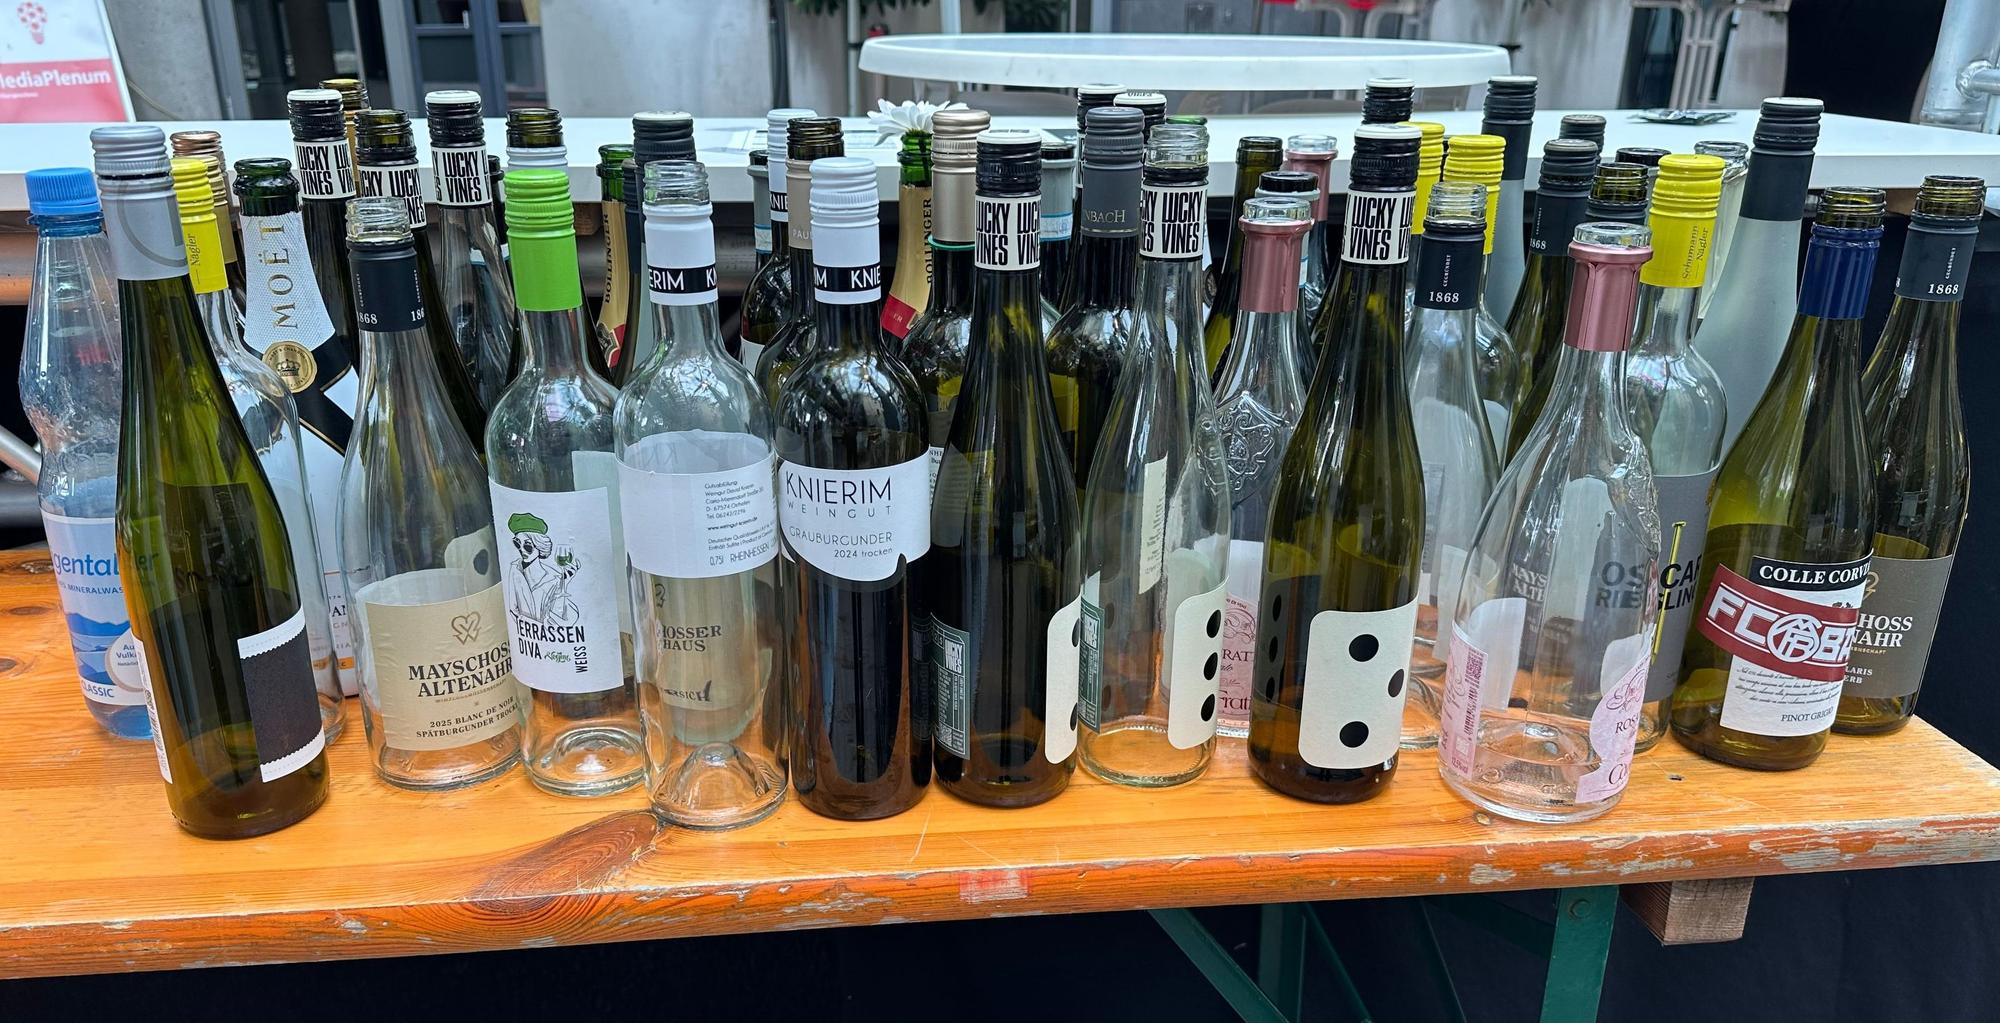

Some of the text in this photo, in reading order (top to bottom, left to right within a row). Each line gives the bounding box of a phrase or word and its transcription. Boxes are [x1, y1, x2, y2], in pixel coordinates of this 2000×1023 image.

[297, 145, 330, 170] LUCKY
[442, 151, 478, 177] LUCKY
[301, 171, 334, 195] VINES
[446, 177, 482, 203] VINES
[977, 200, 1010, 234] LUCKY
[1162, 190, 1203, 222] LUCKY
[1351, 196, 1397, 229] LUCKY
[977, 233, 1008, 265] VINES
[1162, 222, 1200, 253] VINES
[1350, 228, 1392, 260] VINES
[258, 220, 298, 329] MOËT
[1428, 291, 1460, 303] 1868
[1927, 283, 1959, 294] 1868
[786, 471, 891, 505] KNIERIM
[787, 500, 892, 518] WEINGUT
[789, 526, 893, 546] GRAUBURGUNDER
[834, 547, 893, 558] 2024 trocken
[1759, 565, 1826, 585] COLLE
[1708, 585, 1780, 648] FC
[516, 616, 586, 644] TERRASSEN
[518, 637, 542, 660] DIVA
[663, 639, 706, 652] HAUS
[573, 645, 588, 674] WEISS
[416, 717, 494, 739] SPÄTBURGUNDER
[429, 719, 452, 728] 2025
[455, 711, 484, 725] BLANC
[486, 705, 497, 716] DE
[1781, 713, 1811, 722] PINOT
